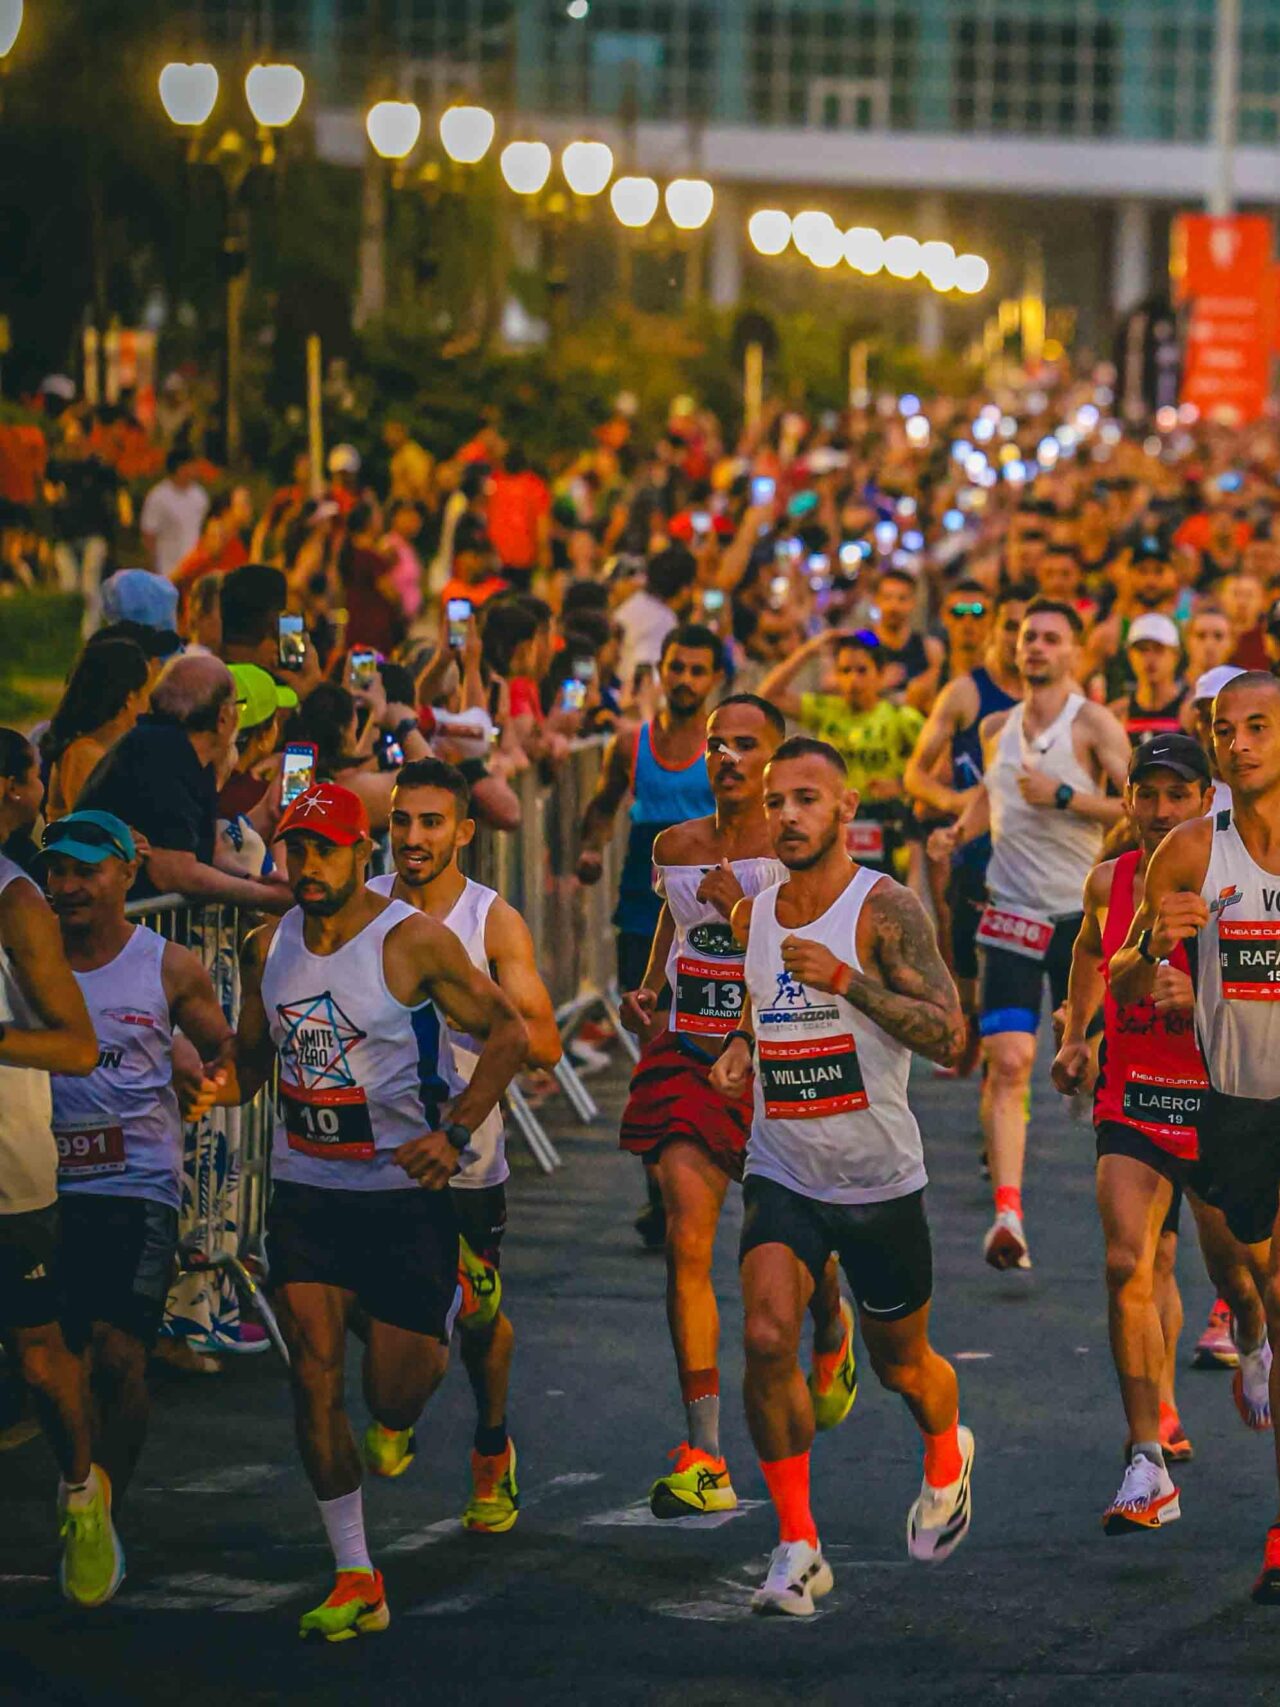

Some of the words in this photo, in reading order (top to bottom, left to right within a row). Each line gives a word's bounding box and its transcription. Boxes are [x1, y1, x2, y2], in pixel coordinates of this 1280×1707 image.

[701, 982, 742, 1009] 13
[771, 1064, 843, 1085] WILLIAN
[800, 1088, 817, 1100] 16
[300, 1106, 339, 1135] 10
[1168, 1113, 1184, 1125] 19
